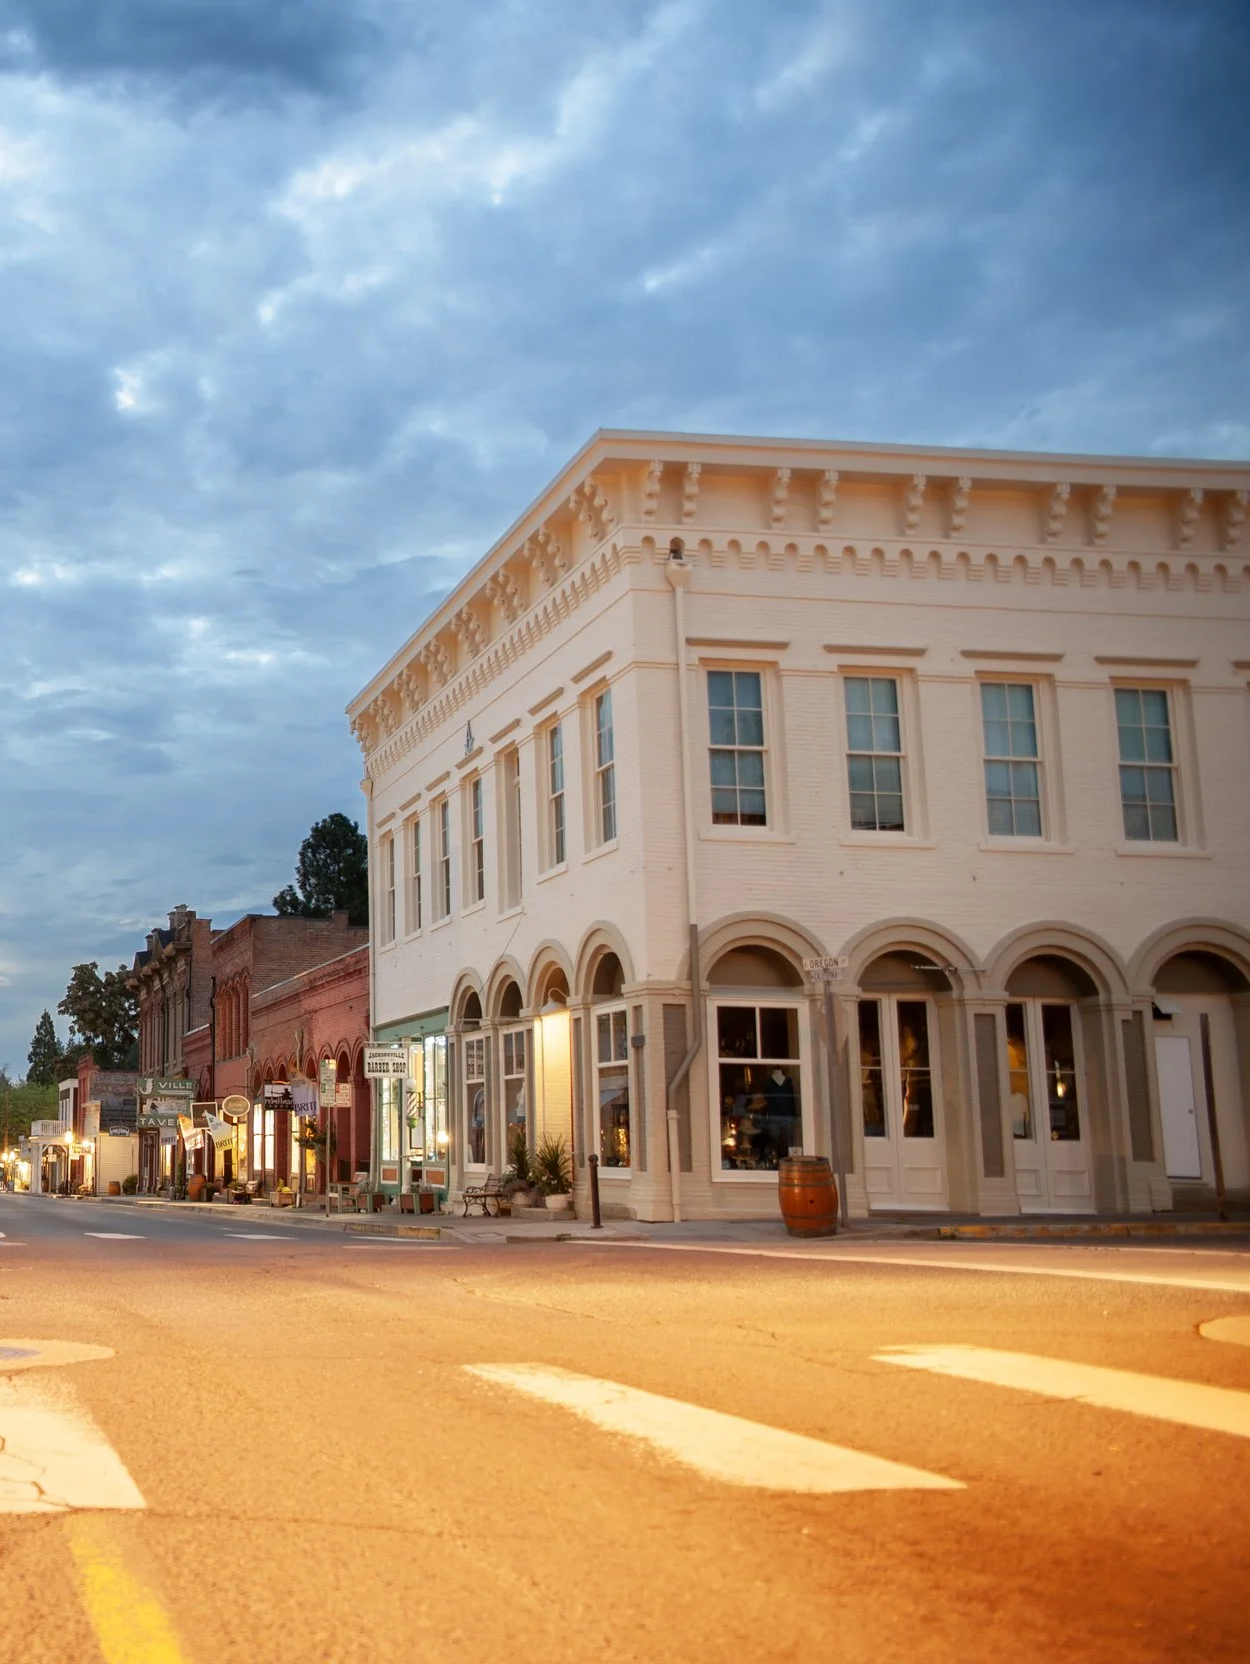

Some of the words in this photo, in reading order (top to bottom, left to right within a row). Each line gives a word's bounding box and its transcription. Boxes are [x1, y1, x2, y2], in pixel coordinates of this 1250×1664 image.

[810, 957, 838, 969] OREGON
[367, 1062, 390, 1073] BARBER
[392, 1062, 406, 1073] SHOP
[139, 1078, 154, 1095] J
[158, 1081, 193, 1089] VILLE
[294, 1101, 317, 1112] BRITT
[215, 1137, 234, 1149] BRITT
